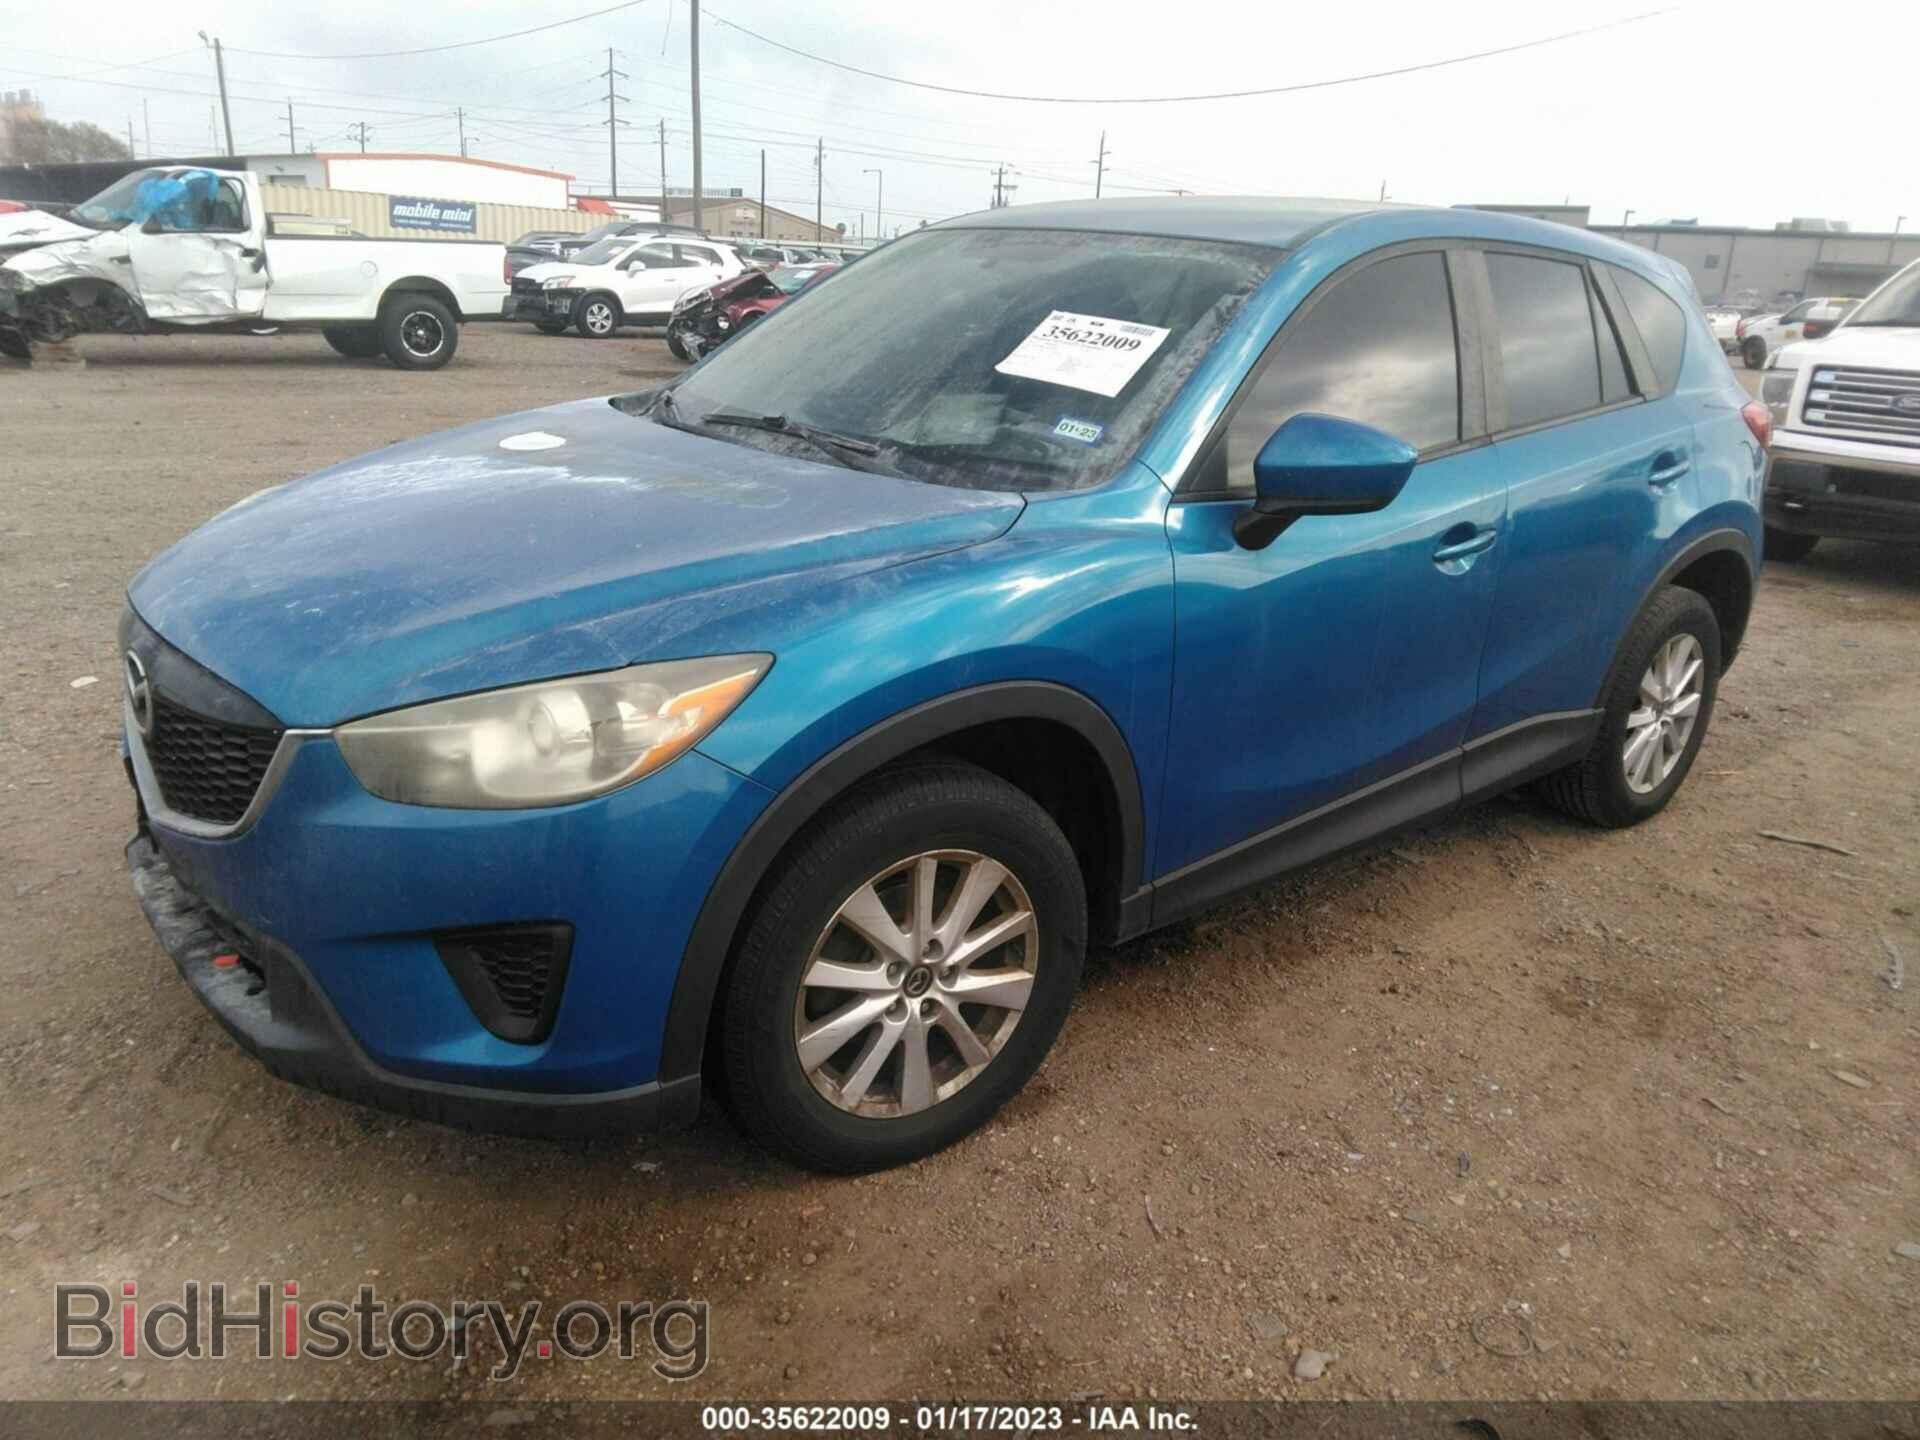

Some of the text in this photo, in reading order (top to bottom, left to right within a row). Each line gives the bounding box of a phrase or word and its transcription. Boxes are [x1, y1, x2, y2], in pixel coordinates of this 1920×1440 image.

[392, 202, 473, 222] mobile mini
[1043, 325, 1142, 351] 35622009
